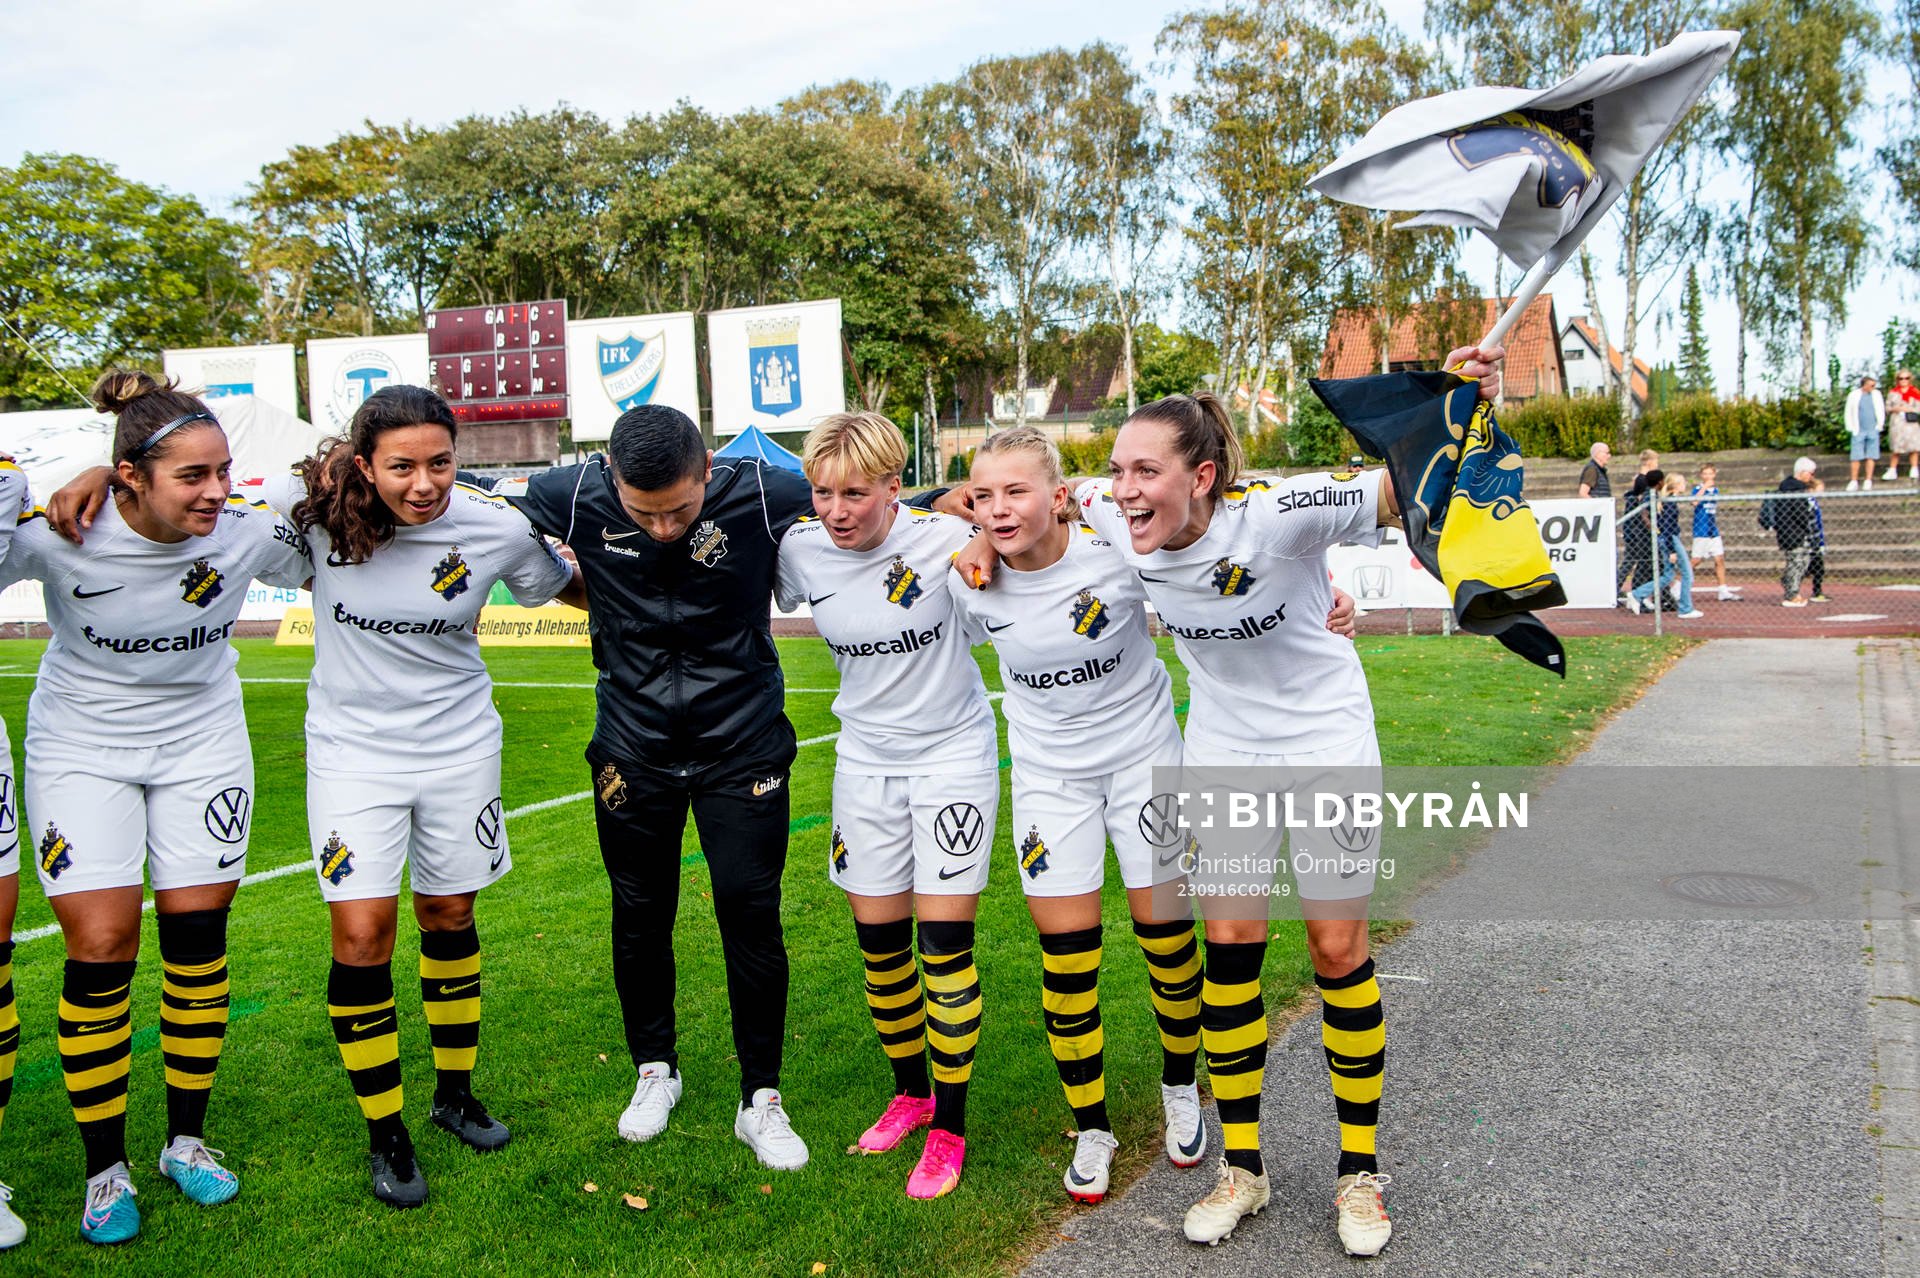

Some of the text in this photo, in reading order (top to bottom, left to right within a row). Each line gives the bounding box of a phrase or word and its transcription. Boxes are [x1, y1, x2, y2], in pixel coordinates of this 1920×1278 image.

[485, 309, 494, 324] G
[496, 309, 504, 323] A
[531, 306, 539, 321] C
[497, 333, 505, 347] B
[532, 330, 540, 345] D
[532, 354, 539, 368] L
[603, 347, 630, 363] IFK
[430, 361, 437, 375] E
[464, 359, 472, 373] G
[497, 356, 505, 371] J
[465, 382, 472, 396] H
[498, 380, 507, 394] K
[533, 378, 543, 392] M
[1278, 486, 1363, 513] stadium
[1541, 515, 1602, 544] ON
[604, 543, 641, 558] truecaller
[272, 587, 297, 603] AB
[332, 602, 467, 636] truecaller
[1157, 603, 1286, 640] truecaller
[478, 619, 590, 638] elleborgs Allehanda
[80, 620, 235, 654] truecaller
[825, 622, 943, 658] truecaller
[1008, 648, 1124, 689] truecaller
[759, 776, 784, 792] nike
[205, 787, 249, 842] VW
[935, 802, 984, 856] VW
